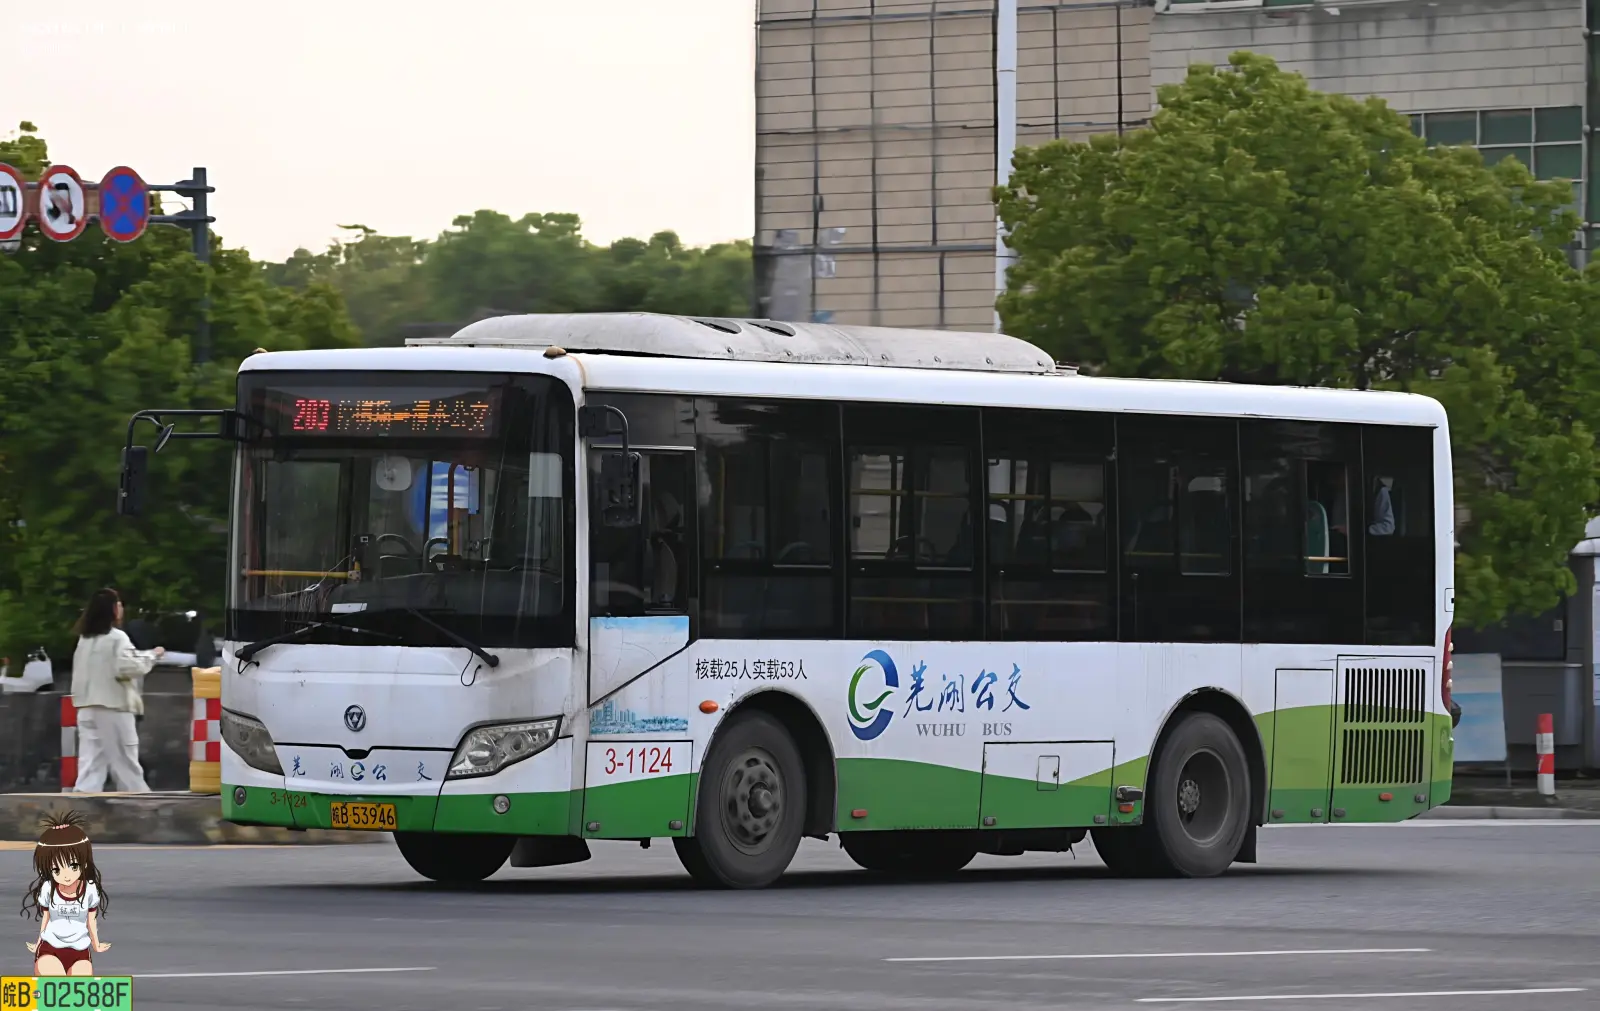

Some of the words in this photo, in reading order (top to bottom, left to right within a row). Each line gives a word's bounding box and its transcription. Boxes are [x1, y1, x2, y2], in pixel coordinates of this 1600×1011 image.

[293, 399, 330, 430] 203
[695, 658, 808, 680] 核载25人实载53人
[903, 660, 1031, 719] 芜湖公交
[916, 723, 966, 737] WUHU
[982, 722, 1012, 736] BUS
[604, 746, 673, 775] 3-1124
[270, 792, 307, 808] 3-1124
